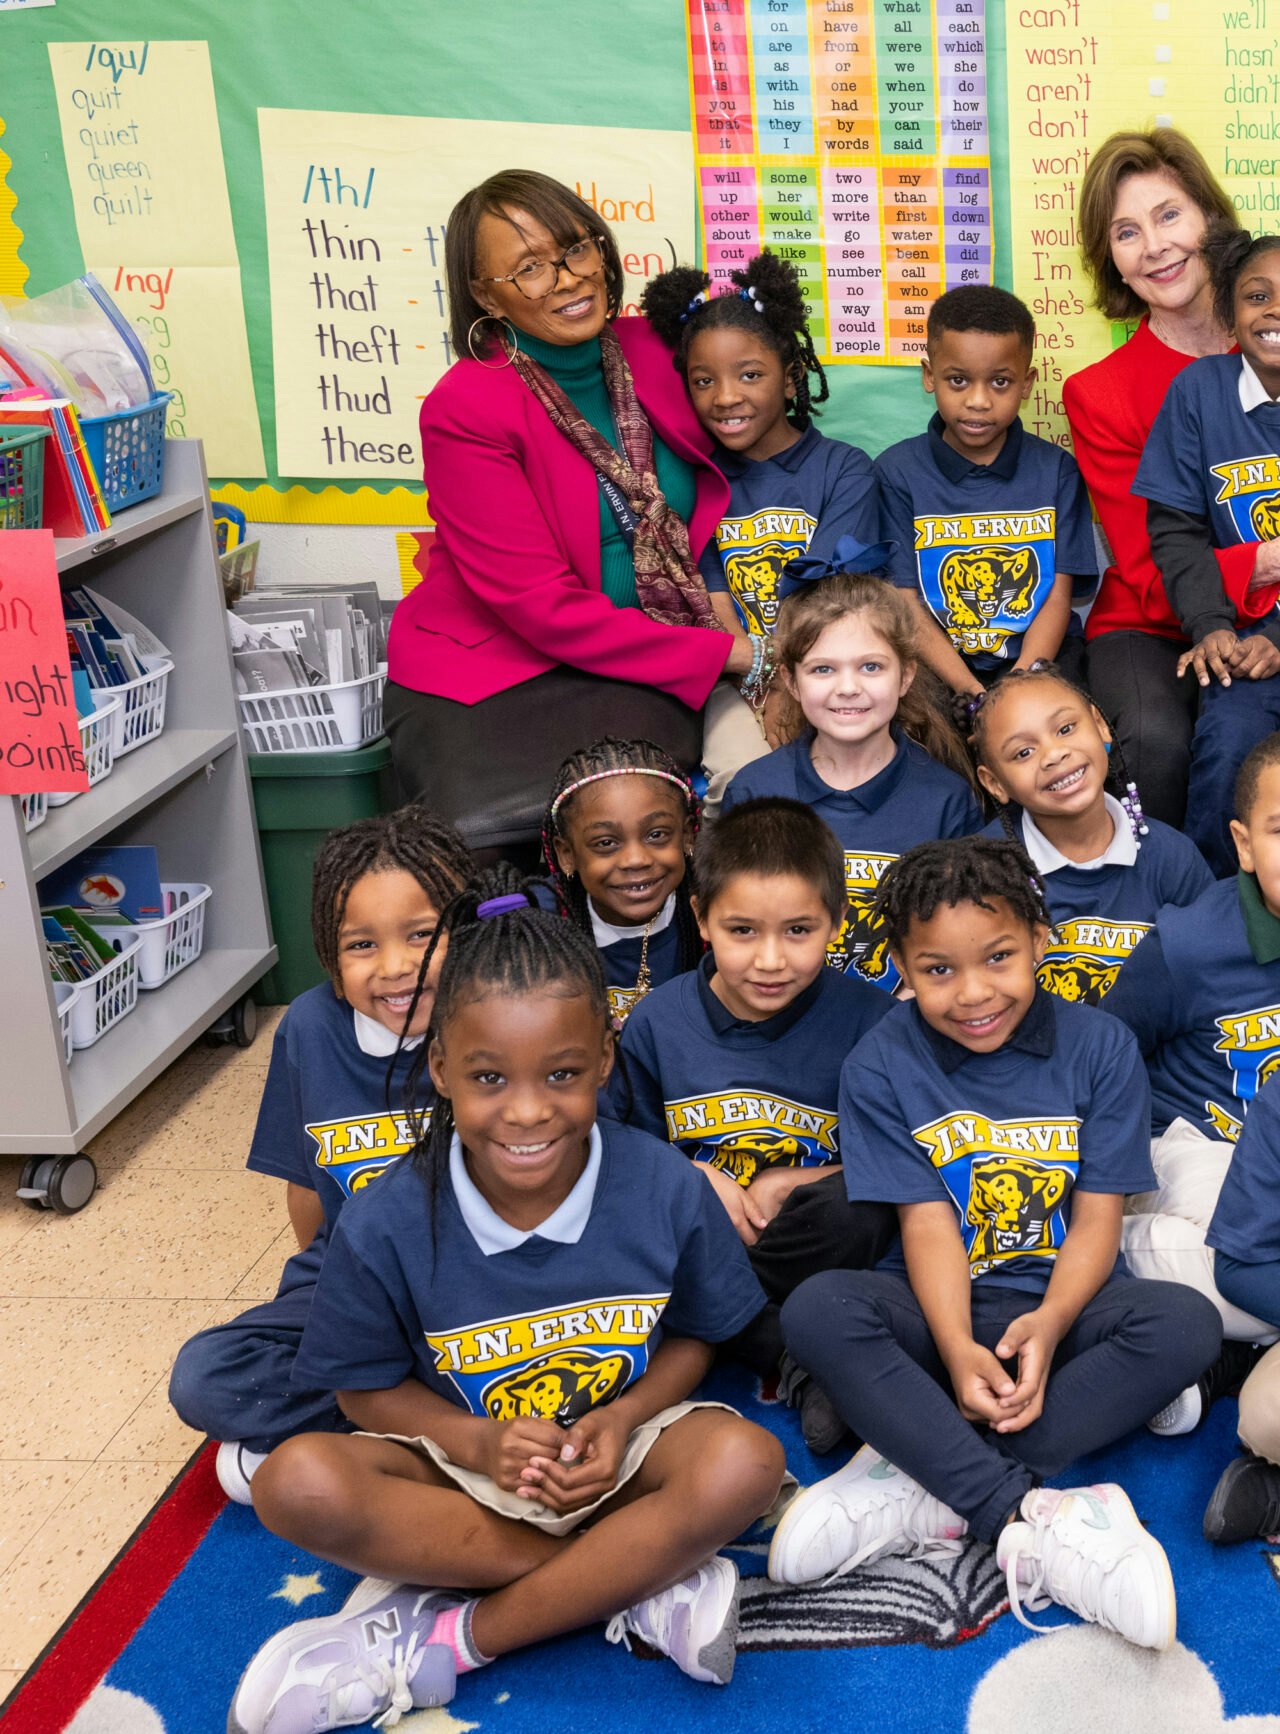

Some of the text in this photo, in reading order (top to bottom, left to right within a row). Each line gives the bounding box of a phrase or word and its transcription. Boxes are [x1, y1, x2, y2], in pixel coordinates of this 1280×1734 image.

[768, 1, 788, 12] for
[826, 1, 854, 12] this
[884, 1, 921, 12] what
[955, 3, 973, 12] an
[1019, 0, 1080, 27] can't
[1223, 0, 1266, 29] we'll
[714, 22, 722, 32] a
[771, 22, 788, 32] on
[824, 21, 858, 32] have
[894, 21, 912, 32] all
[949, 21, 979, 32] each
[712, 41, 726, 51] to
[768, 42, 792, 52] are
[825, 40, 859, 52] from
[886, 43, 922, 52] were
[945, 41, 983, 52] which
[1025, 37, 1098, 65] wasn't
[714, 60, 728, 71] in
[774, 62, 789, 71] as
[835, 62, 851, 72] or
[895, 63, 915, 72] we
[954, 61, 977, 72] she
[715, 80, 727, 90] is
[766, 80, 799, 91] with
[831, 82, 857, 91] one
[886, 80, 925, 92] when
[958, 81, 974, 92] do
[1027, 73, 1091, 102] aren't
[1224, 73, 1280, 103] didn't
[72, 86, 122, 120] quit
[709, 100, 736, 112] you
[773, 99, 794, 110] his
[832, 100, 858, 111] had
[889, 101, 924, 113] your
[953, 100, 979, 111] how
[708, 119, 740, 129] that
[769, 119, 801, 132] they
[837, 119, 854, 132] by
[895, 122, 920, 131] can
[951, 120, 982, 131] their
[1028, 109, 1088, 137] don't
[79, 120, 138, 159] quiet
[720, 138, 731, 148] it
[784, 138, 789, 149] I
[825, 139, 869, 150] words
[894, 139, 923, 150] said
[963, 139, 974, 150] if
[1032, 148, 1090, 174] won't
[87, 161, 151, 195] queen
[714, 172, 741, 183] will
[770, 174, 807, 183] some
[836, 173, 862, 183] two
[899, 175, 921, 186] my
[955, 173, 981, 185] find
[720, 193, 738, 204] up
[778, 191, 802, 202] her
[832, 193, 868, 202] more
[895, 192, 927, 202] than
[960, 192, 978, 205] log
[1034, 182, 1075, 210] isn't
[93, 186, 153, 225] quilt
[711, 210, 750, 221] other
[769, 210, 812, 221] would
[832, 212, 870, 222] write
[896, 211, 927, 222] first
[952, 212, 985, 222] down
[301, 218, 381, 262] thin
[712, 229, 751, 240] about
[773, 229, 812, 240] make
[844, 231, 860, 242] go
[892, 232, 932, 241] water
[958, 230, 980, 244] day
[721, 249, 744, 259] out
[780, 248, 806, 259] like
[842, 250, 865, 259] see
[896, 248, 929, 259] been
[960, 249, 979, 260] did
[827, 267, 882, 277] number
[1032, 252, 1072, 281] I'm
[901, 268, 926, 278] call
[961, 269, 979, 281] get
[309, 272, 379, 312] that
[847, 286, 863, 295] no
[900, 286, 928, 296] who
[1033, 287, 1084, 315] she's
[842, 305, 870, 316] way
[904, 306, 925, 315] am
[838, 322, 876, 332] could
[907, 323, 924, 333] its
[315, 324, 401, 365] theft
[836, 340, 880, 352] people
[317, 374, 392, 415] thud
[321, 426, 415, 465] these
[1230, 463, 1272, 494] J.N.
[603, 481, 625, 512] ERVIN
[924, 514, 1051, 547] J.N. ERVIN
[666, 1097, 825, 1139] J.N. ERVIN
[321, 1123, 386, 1163] J.N.
[935, 1118, 985, 1162] J.N.
[444, 1303, 666, 1370] J.N. ERVIN
